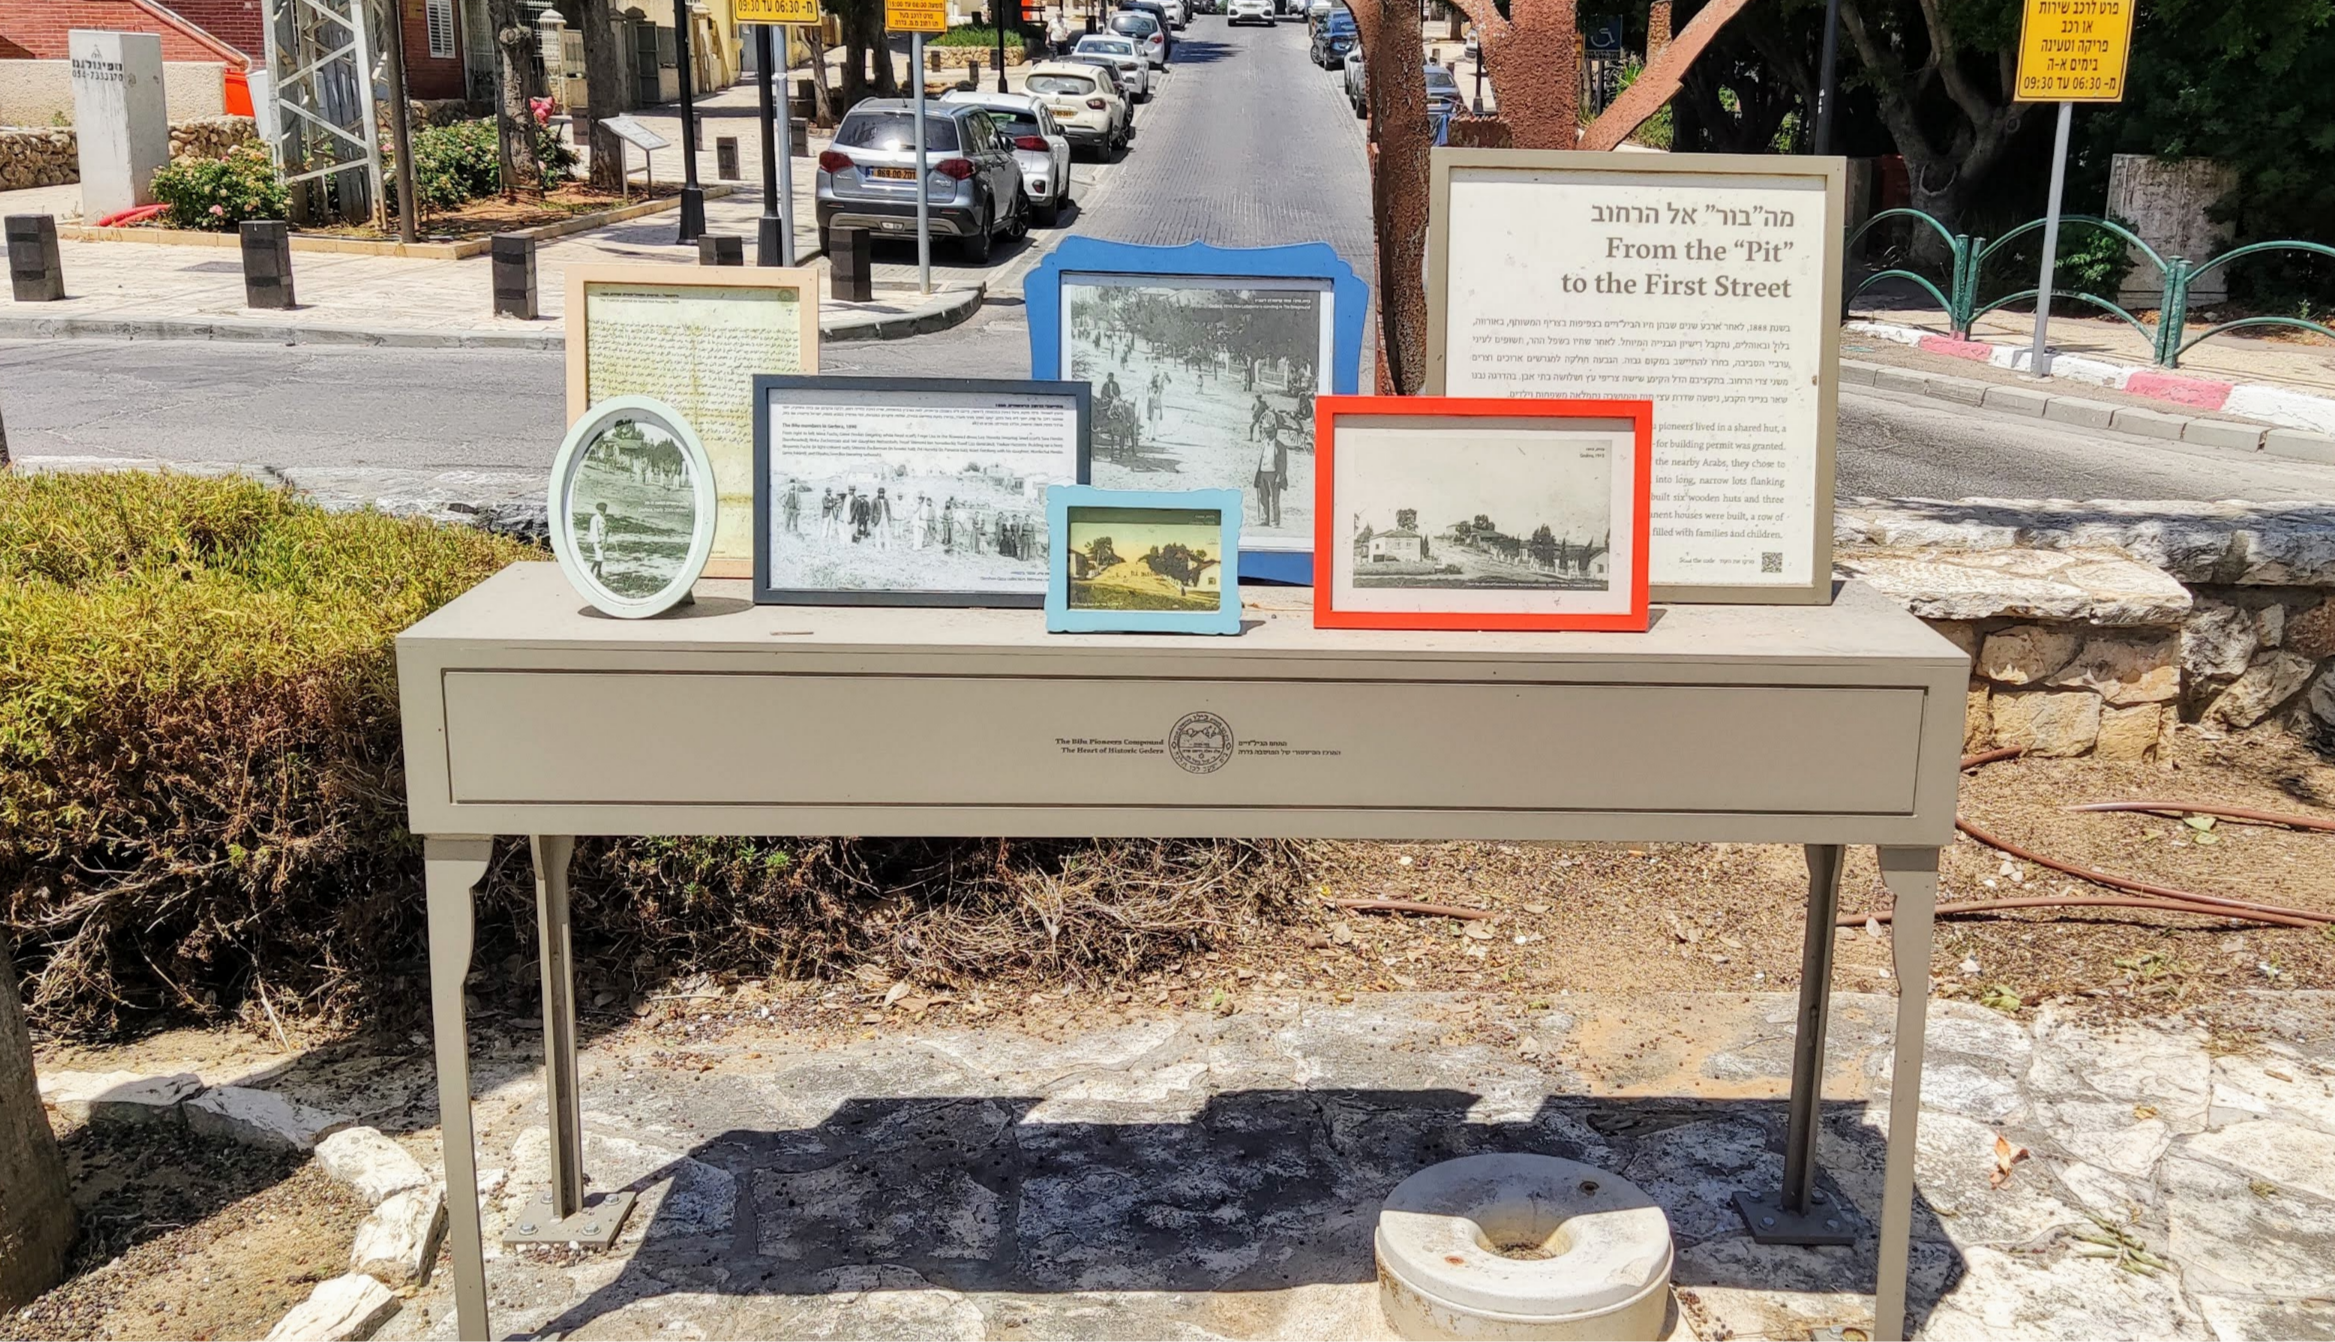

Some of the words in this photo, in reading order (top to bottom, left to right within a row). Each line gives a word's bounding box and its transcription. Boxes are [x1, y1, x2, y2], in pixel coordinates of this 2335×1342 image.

[738, 0, 760, 12] 09:30
[775, 0, 799, 13] 06:30
[2039, 0, 2070, 15] שירות
[2073, 0, 2097, 15] לרכב
[2099, 1, 2119, 15] פרט
[2061, 20, 2079, 34] רכב
[2082, 20, 2094, 34] או
[2040, 38, 2075, 53] וטעינה
[2077, 39, 2109, 55] פריקה
[2046, 58, 2068, 72] א-ה
[2070, 58, 2098, 72] בימים
[2024, 76, 2054, 90] 09:30
[2056, 76, 2070, 90] עד
[2072, 76, 2102, 90] 06:30
[1590, 204, 1660, 224] הרחוב
[1666, 202, 1698, 225] אל
[1605, 237, 1678, 260] From
[1684, 239, 1727, 261] the
[1561, 273, 1587, 293] to
[1594, 271, 1637, 295] the
[1644, 273, 1707, 297] First
[1714, 274, 1792, 298] Street
[1658, 422, 1694, 432] pioneers
[1694, 422, 1716, 431] lived
[1716, 423, 1726, 431] in
[1734, 423, 1762, 432] shared
[1763, 424, 1780, 434] hut,
[1670, 440, 1704, 450] building
[1706, 440, 1734, 451] permit
[1752, 441, 1786, 452] granted.
[1654, 457, 1668, 466] the
[1670, 458, 1700, 468] nearby
[1702, 459, 1729, 469] Arabs,
[1730, 459, 1750, 470] they
[1752, 459, 1774, 468] chose
[1776, 460, 1786, 468] to
[1656, 475, 1672, 483] into
[1732, 476, 1748, 485] lots
[1750, 477, 1786, 487] flanking
[1674, 493, 1686, 502] six
[1688, 494, 1720, 502] wooden
[1722, 494, 1742, 503] huts
[1744, 495, 1760, 503] and
[1762, 495, 1784, 504] three
[1674, 511, 1702, 520] houses
[1726, 512, 1749, 523] built,
[1774, 513, 1785, 522] of
[1652, 528, 1674, 536] filled
[1675, 528, 1694, 537] with
[1696, 529, 1729, 537] families
[1730, 529, 1746, 538] and
[1746, 530, 1784, 538] children.
